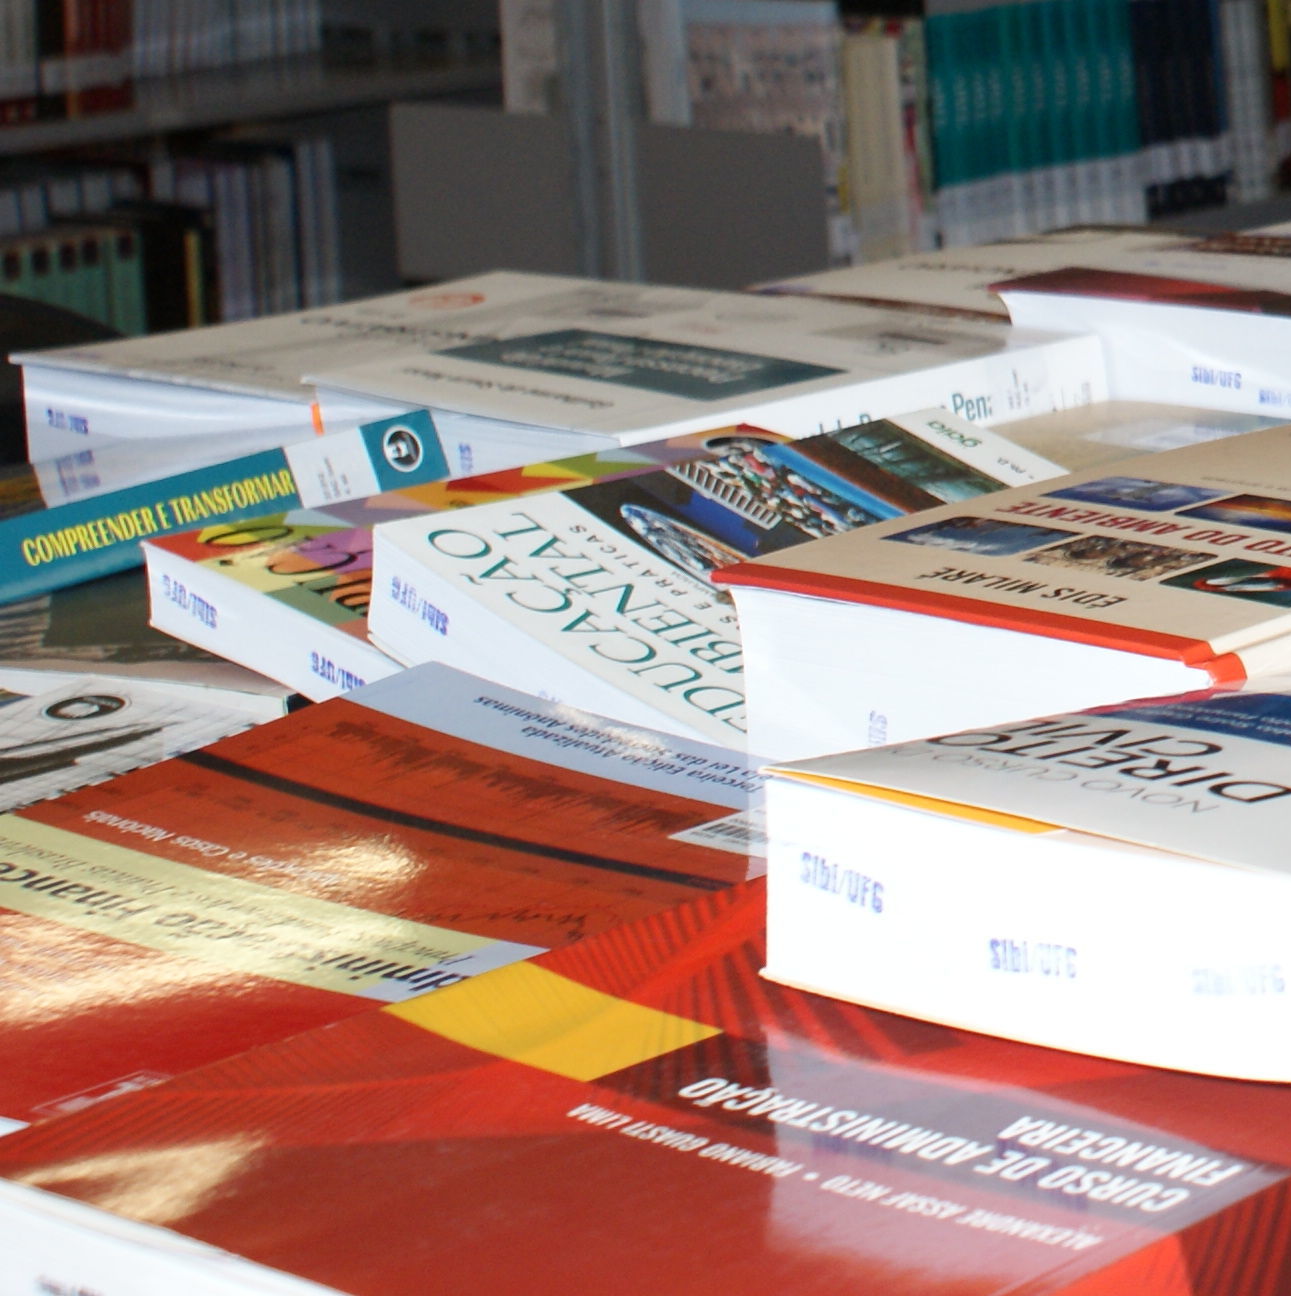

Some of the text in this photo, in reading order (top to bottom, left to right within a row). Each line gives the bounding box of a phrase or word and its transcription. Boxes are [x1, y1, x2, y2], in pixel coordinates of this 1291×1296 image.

[21, 510, 157, 568] COMPREENDER
[156, 499, 171, 528] E
[170, 467, 296, 525] TRANSFORMAR
[994, 501, 1185, 540] AMBIENTE
[1182, 526, 1247, 551] DO
[918, 565, 1129, 611] ÉDIS MILARÉ
[472, 693, 567, 732] Anônimas
[519, 725, 618, 762] Atualizada
[998, 720, 1223, 758] CIVIL
[620, 752, 685, 777] Edição
[1081, 779, 1221, 815] NOVO
[82, 809, 175, 843] Nacionais
[169, 835, 231, 859] Casos
[677, 1077, 1192, 1213] CURSO DE ADMINISTRAÇÃO
[996, 1114, 1246, 1187] FINANCEIRA
[565, 1102, 1106, 1251] ALEXANDRE ASSAF NETO FABIANO GUASTI LIMA
